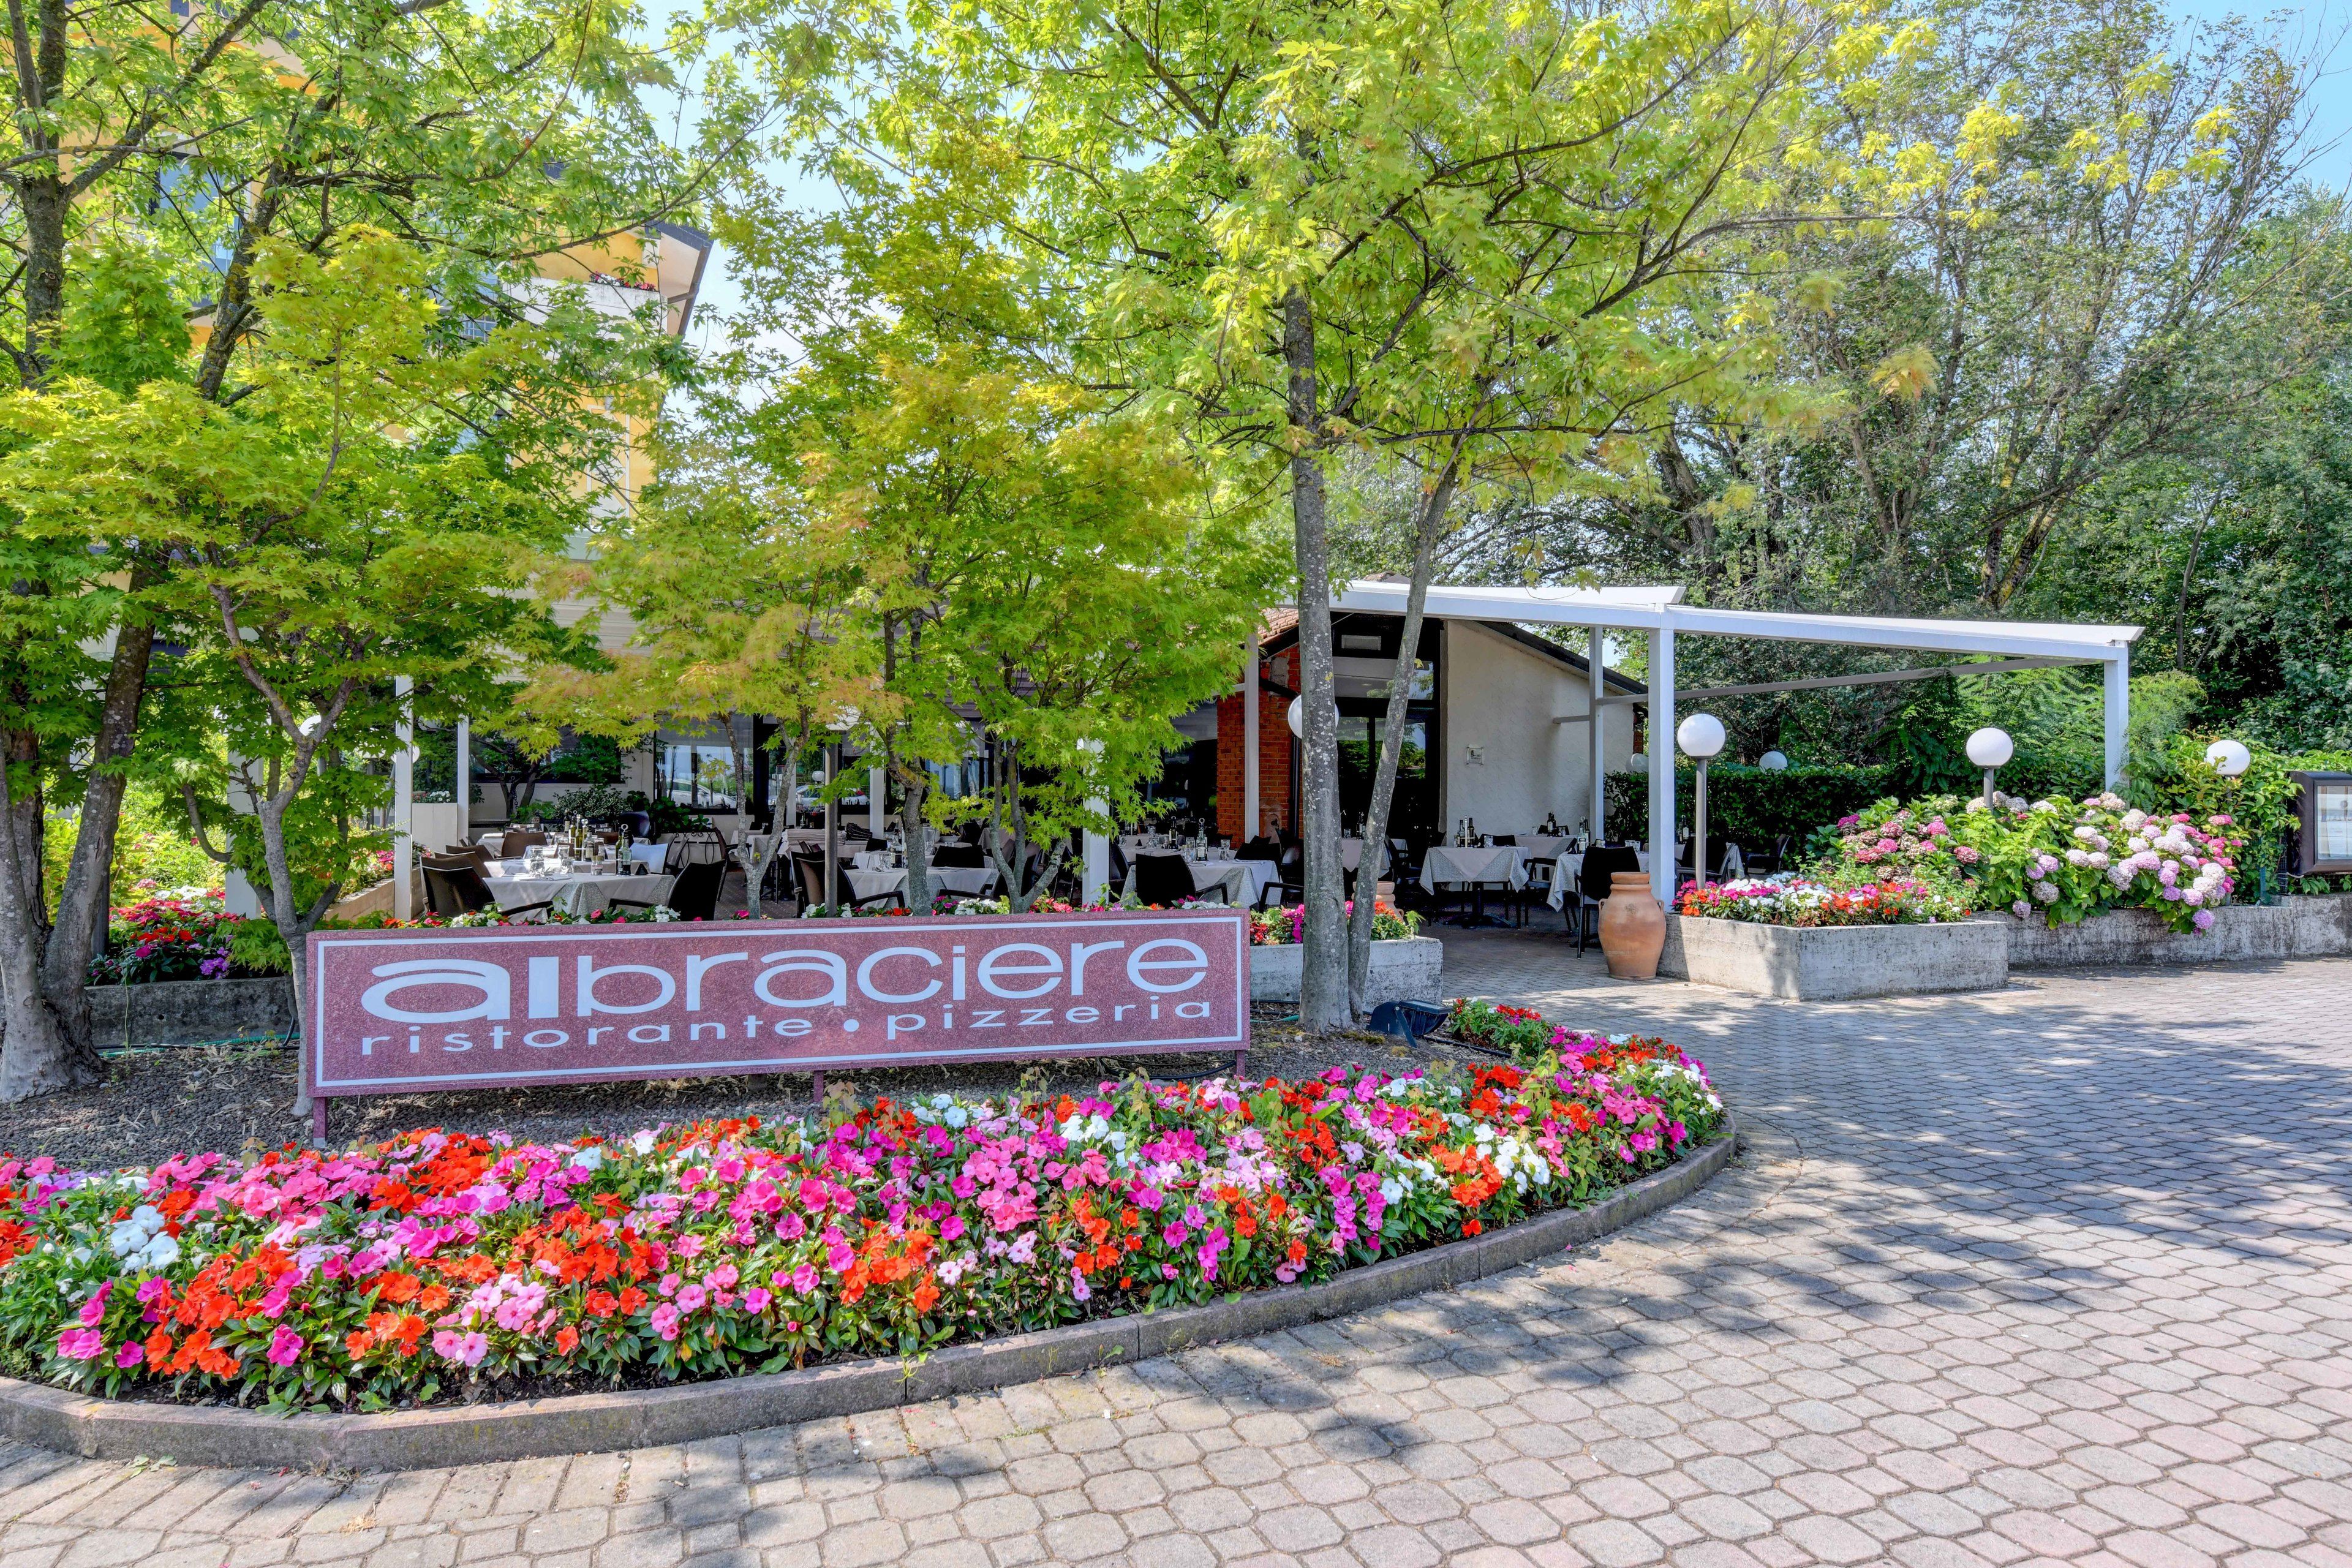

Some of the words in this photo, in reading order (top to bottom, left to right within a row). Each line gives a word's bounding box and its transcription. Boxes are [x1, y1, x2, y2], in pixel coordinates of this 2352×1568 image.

[361, 938, 1208, 1023] albraciere
[361, 1015, 813, 1055] ristorante
[888, 995, 1210, 1039] pizzeria
